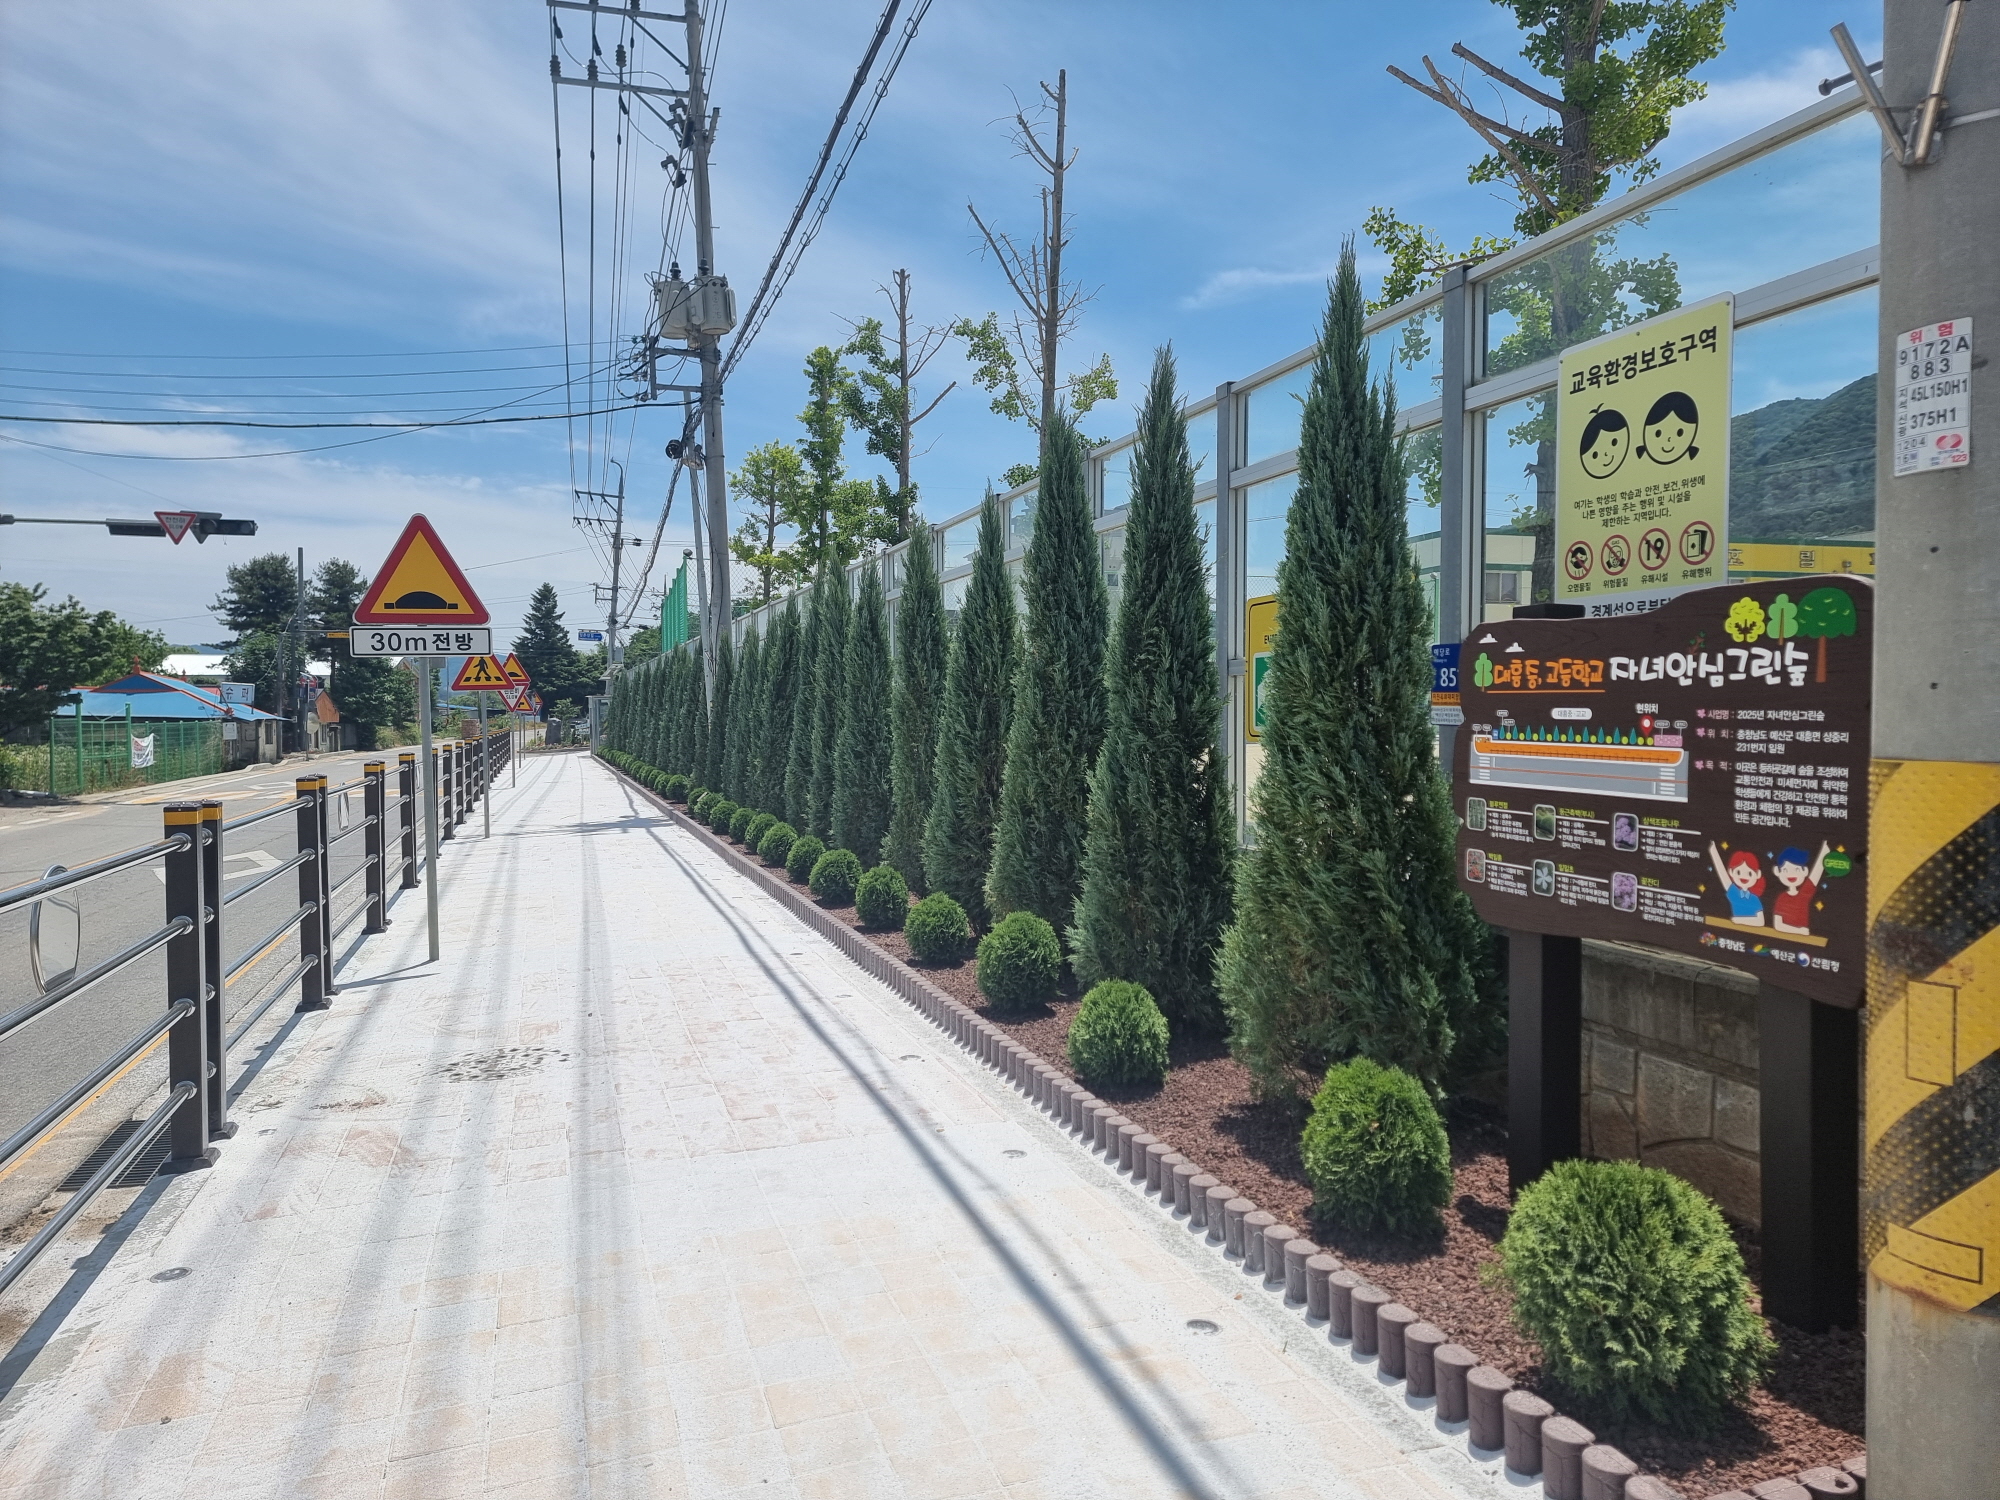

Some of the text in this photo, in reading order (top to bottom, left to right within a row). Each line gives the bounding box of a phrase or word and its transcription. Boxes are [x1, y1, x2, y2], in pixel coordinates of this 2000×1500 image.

[1900, 336, 1970, 365] 9172A
[1570, 326, 1717, 395] 교육환경보호구역
[1911, 358, 1950, 380] 883
[1910, 407, 1957, 430] 375H1
[1574, 499, 1593, 510] 여기는
[1596, 493, 1617, 506] 학생의
[1620, 488, 1642, 501] 학습과
[1599, 505, 1619, 517] 영향을
[1622, 502, 1637, 513] 주는
[1640, 498, 1654, 510] 행위
[1658, 496, 1664, 507] 및
[1668, 490, 1691, 503] 시설을
[1602, 507, 1671, 528] 제한하는 지역입니다.
[1645, 538, 1664, 561] 19
[1640, 573, 1669, 584] 유해시설
[1682, 567, 1712, 579] 유해행위
[1567, 582, 1592, 593] 오염물질
[1603, 577, 1629, 588] 위험물질
[1546, 658, 1604, 687] 고등학교
[1609, 642, 1809, 688] 자녀안심그린숲
[1440, 668, 1456, 687] 85
[1636, 703, 1658, 714] 현위치
[1708, 710, 1729, 719] 사업명
[1737, 710, 1764, 720] 2025년
[1767, 710, 1825, 722] 자녀안심그린숲
[1737, 729, 1768, 741] 충청남도
[1770, 731, 1794, 741] 예산군
[1796, 731, 1820, 742] 대흥면
[1823, 732, 1849, 743] 상중리
[1736, 743, 1785, 754] 231번지 일원
[1736, 762, 1757, 773] 이곳은
[1798, 765, 1814, 776] 숲을
[1816, 766, 1849, 778] 조성하여
[1735, 775, 1848, 792] 교통안전과 미세먼지에 취약한
[1735, 787, 1771, 799] 학생들에게
[1773, 790, 1803, 802] 건강하고
[1805, 792, 1829, 804] 안전한
[1734, 800, 1848, 819] 환경과 체험의 장 제공을 위하여
[1734, 813, 1791, 828] 만든 공간입니다.
[1824, 859, 1850, 870] GREEN
[1719, 938, 1840, 973] 충청남도 예산군 산림청
